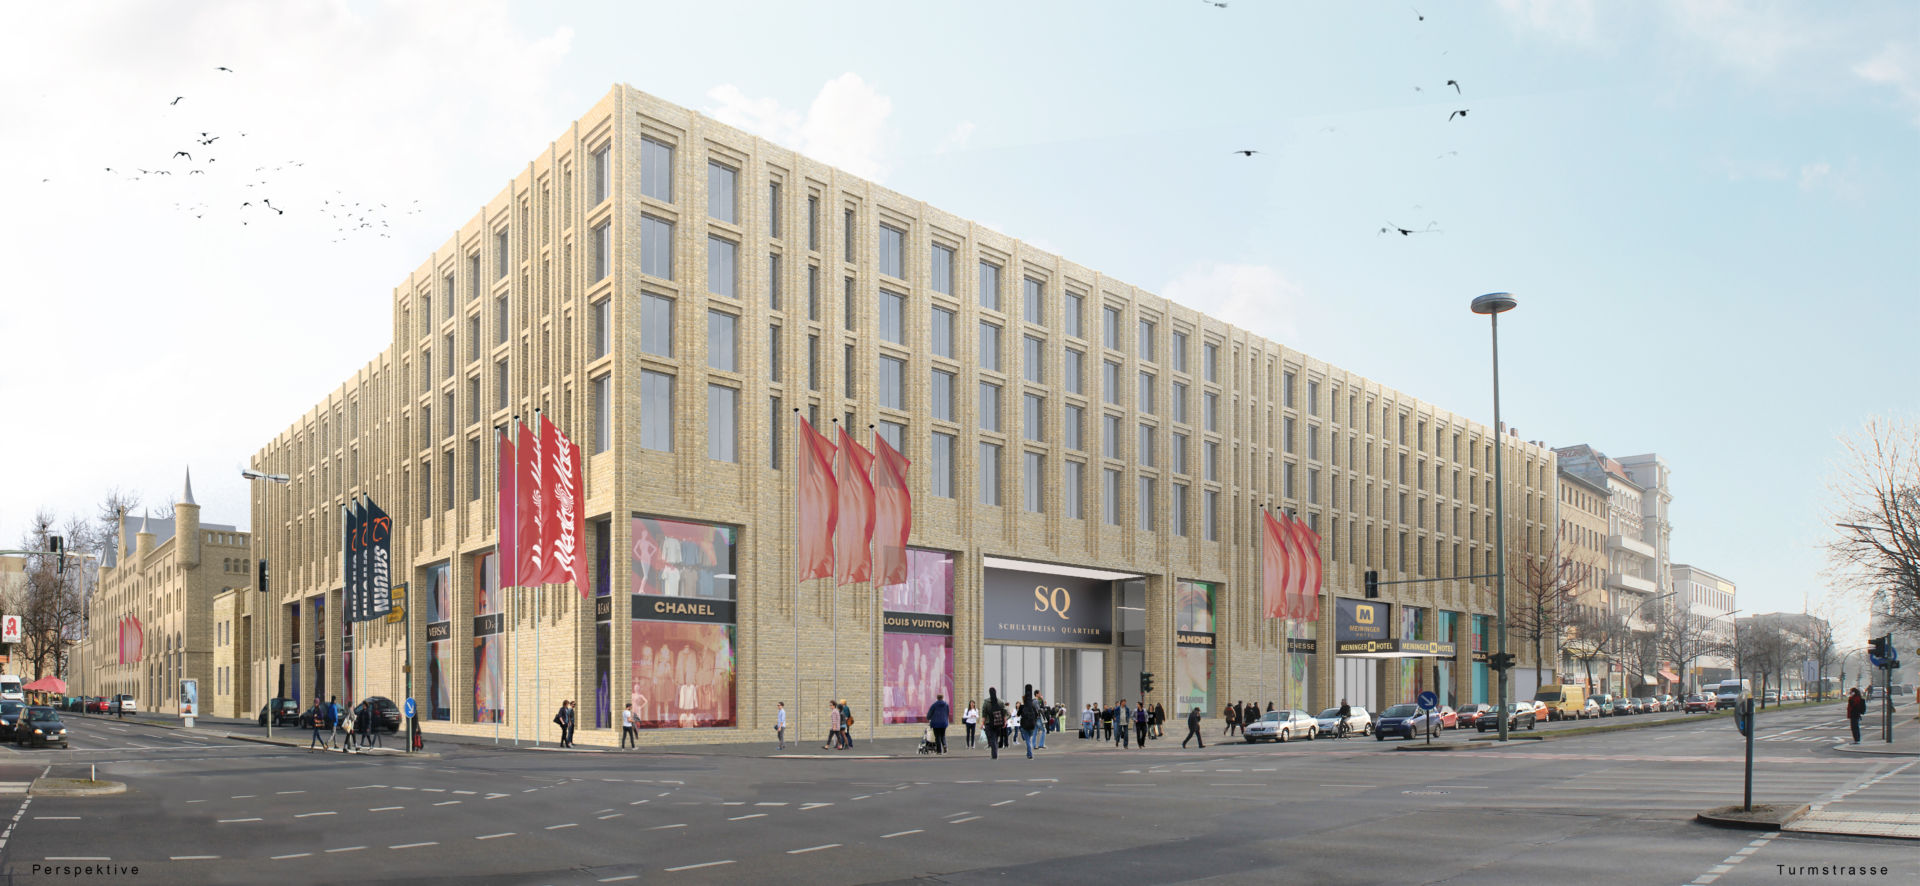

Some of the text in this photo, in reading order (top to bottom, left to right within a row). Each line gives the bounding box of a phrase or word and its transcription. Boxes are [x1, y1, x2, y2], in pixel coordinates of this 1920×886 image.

[374, 544, 390, 613] SATURN
[654, 601, 715, 616] CHANEL
[1034, 585, 1071, 620] SQ
[485, 619, 500, 630] Dir
[884, 617, 950, 629] LOUIS VUITTON
[998, 622, 1100, 636] SCHULTHEISS QUARTIER
[1341, 643, 1368, 651] MEININGER
[1376, 642, 1393, 650] HOTEL
[1402, 642, 1429, 651] MEININGER
[1438, 644, 1454, 653] HOTEL
